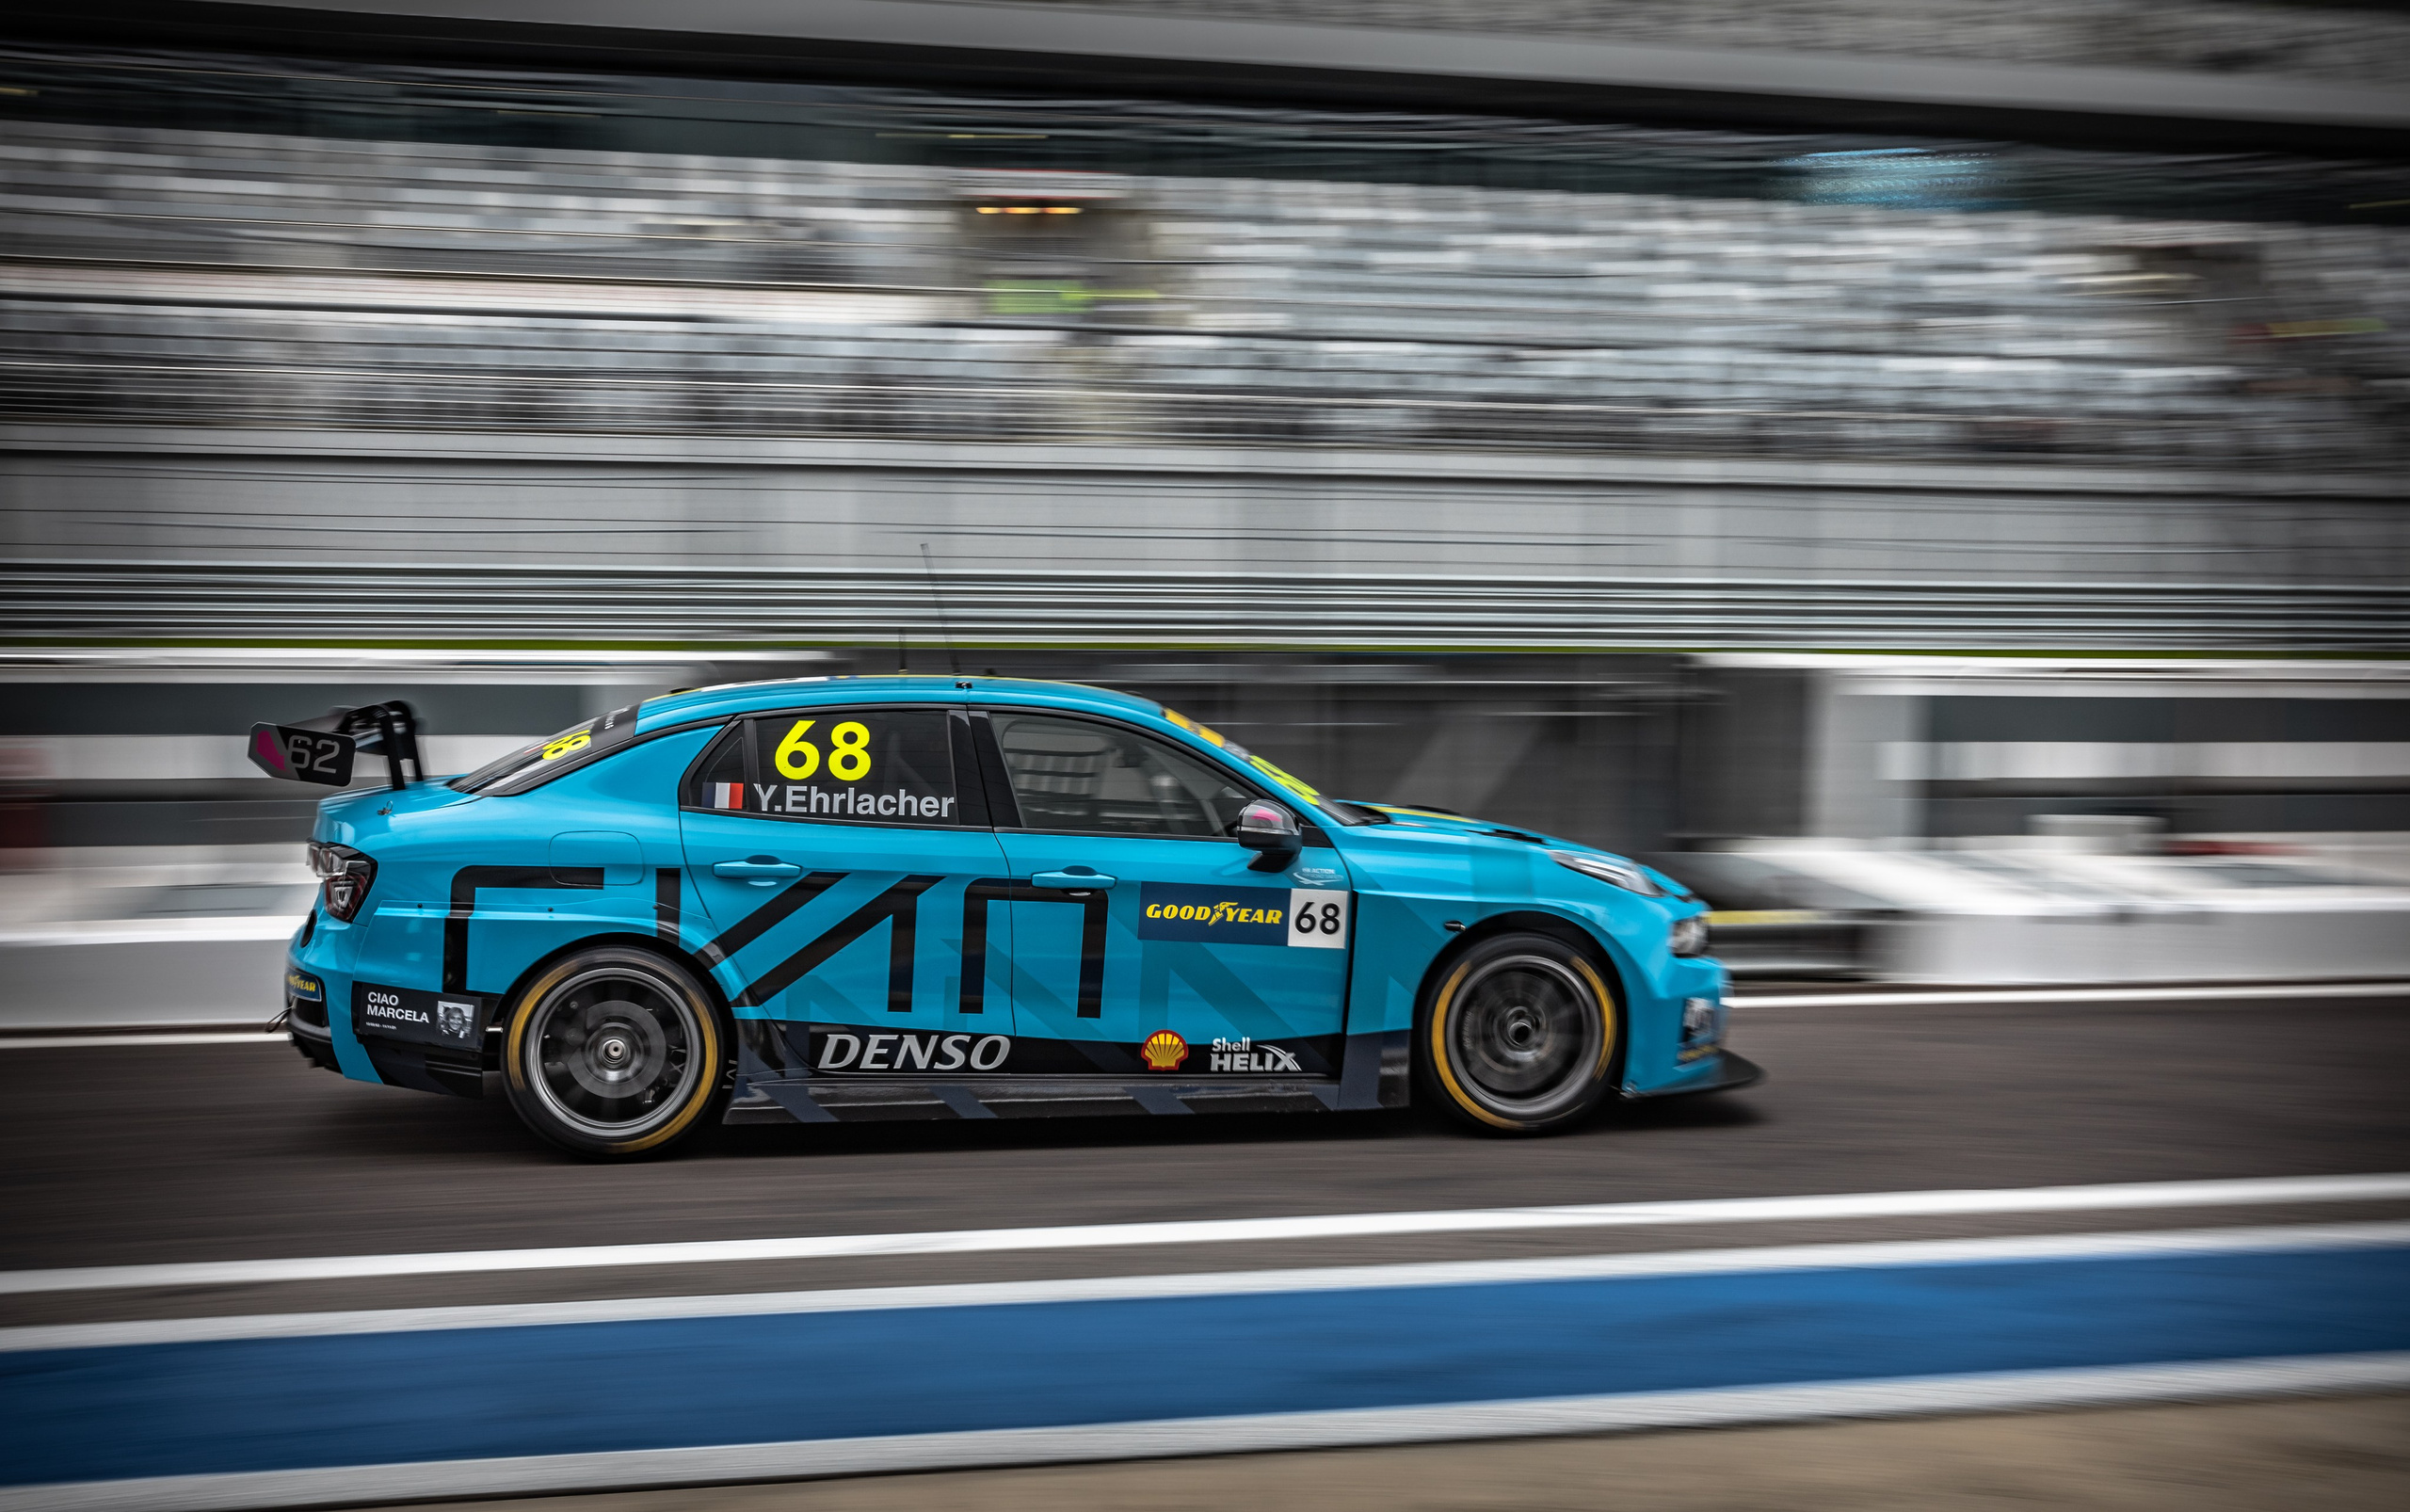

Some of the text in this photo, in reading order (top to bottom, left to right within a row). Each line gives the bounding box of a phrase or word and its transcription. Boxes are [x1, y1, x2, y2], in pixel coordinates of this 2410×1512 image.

[287, 734, 341, 775] 62
[775, 720, 872, 781] 68
[753, 783, 955, 818] Y.Ehrlacher
[1294, 901, 1341, 936] 68
[366, 1005, 429, 1023] MARCELA
[367, 991, 399, 1005] CIAO
[817, 1034, 1012, 1070] DENSO
[1210, 1045, 1302, 1072] HELIX
[1212, 1037, 1250, 1053] Shell
